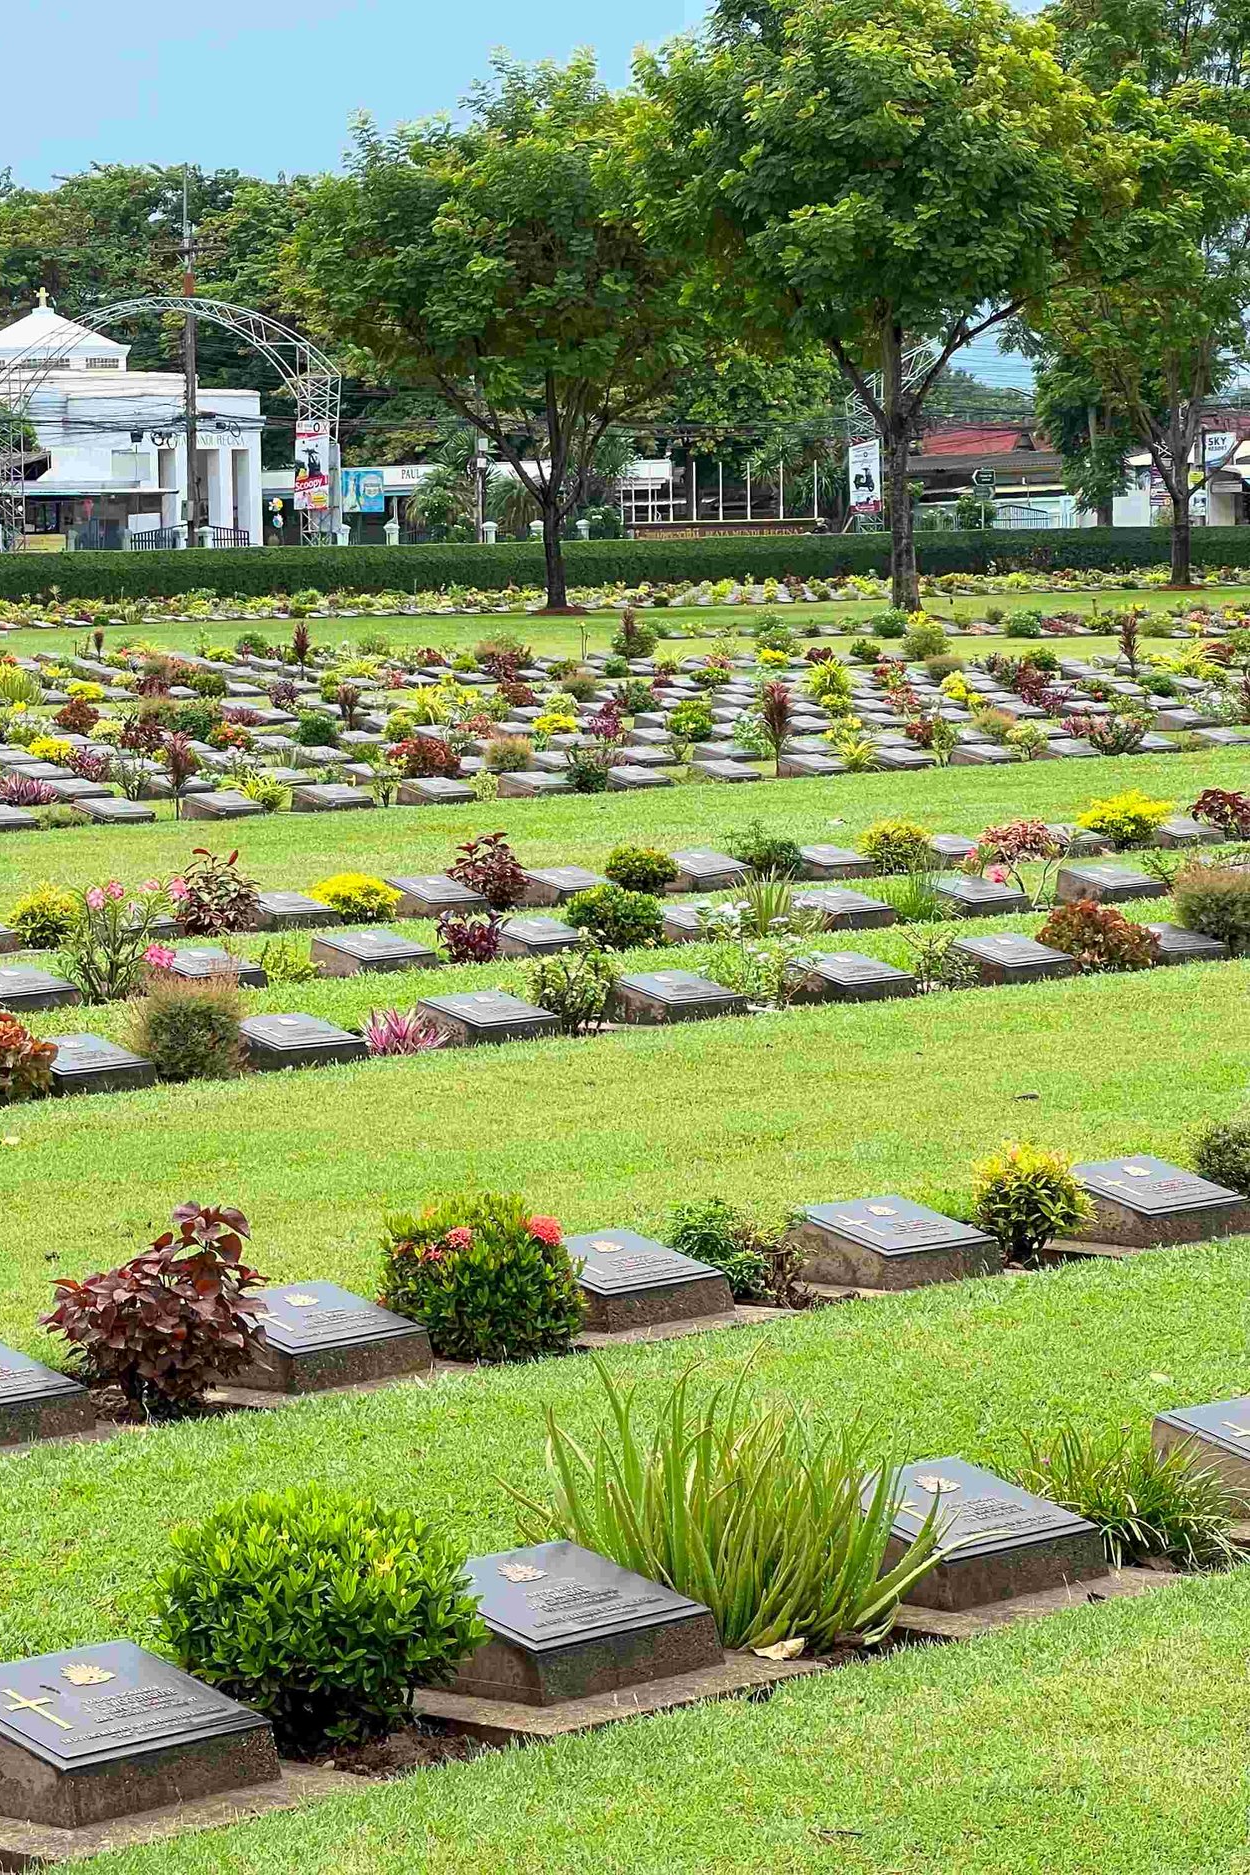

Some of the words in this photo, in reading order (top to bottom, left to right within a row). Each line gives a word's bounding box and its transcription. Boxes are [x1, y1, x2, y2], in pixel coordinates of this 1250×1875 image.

[1208, 437, 1227, 446] SKY
[295, 478, 322, 490] Scoopy
[732, 529, 760, 537] MUNDI
[763, 528, 799, 537] REGINA
